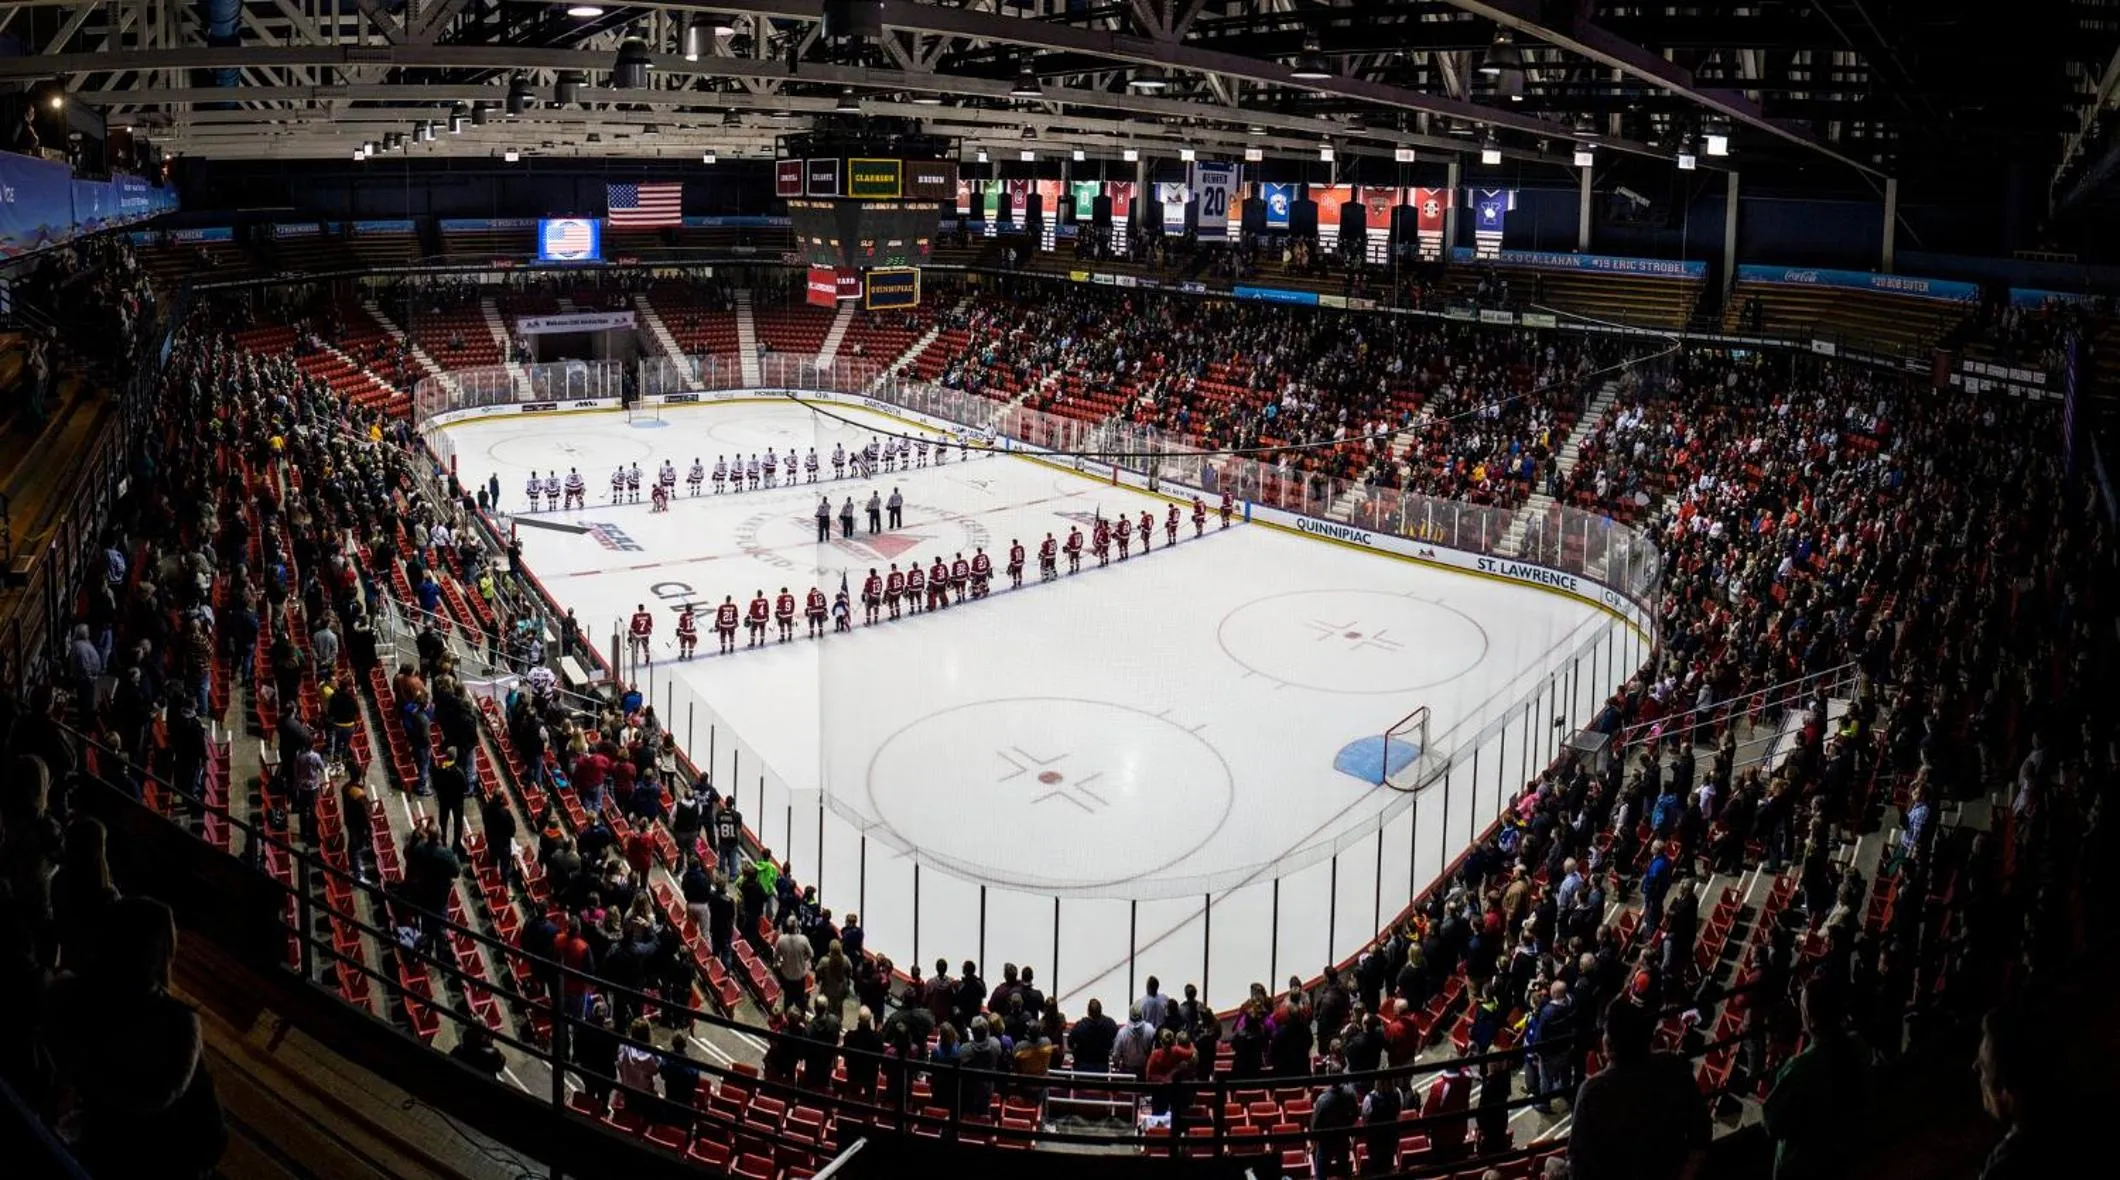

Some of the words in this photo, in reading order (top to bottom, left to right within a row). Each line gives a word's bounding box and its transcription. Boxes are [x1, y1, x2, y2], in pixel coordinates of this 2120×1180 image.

[855, 174, 895, 182] CLARKSON
[918, 175, 944, 184] BROWN
[1203, 186, 1226, 217] 20
[1613, 258, 1636, 270] ERIC
[1639, 260, 1688, 273] STROBEL
[870, 284, 913, 294] QUINNIPIAC
[864, 398, 902, 417] DARTMOUTH
[1296, 517, 1372, 545] QUINNIPIAC
[1477, 558, 1497, 573] ST.
[1500, 562, 1578, 591] LAWRENCE
[723, 611, 734, 622] 21
[758, 605, 764, 617] 4
[639, 621, 645, 631] 7
[534, 678, 548, 689] 27
[720, 823, 736, 838] 81
